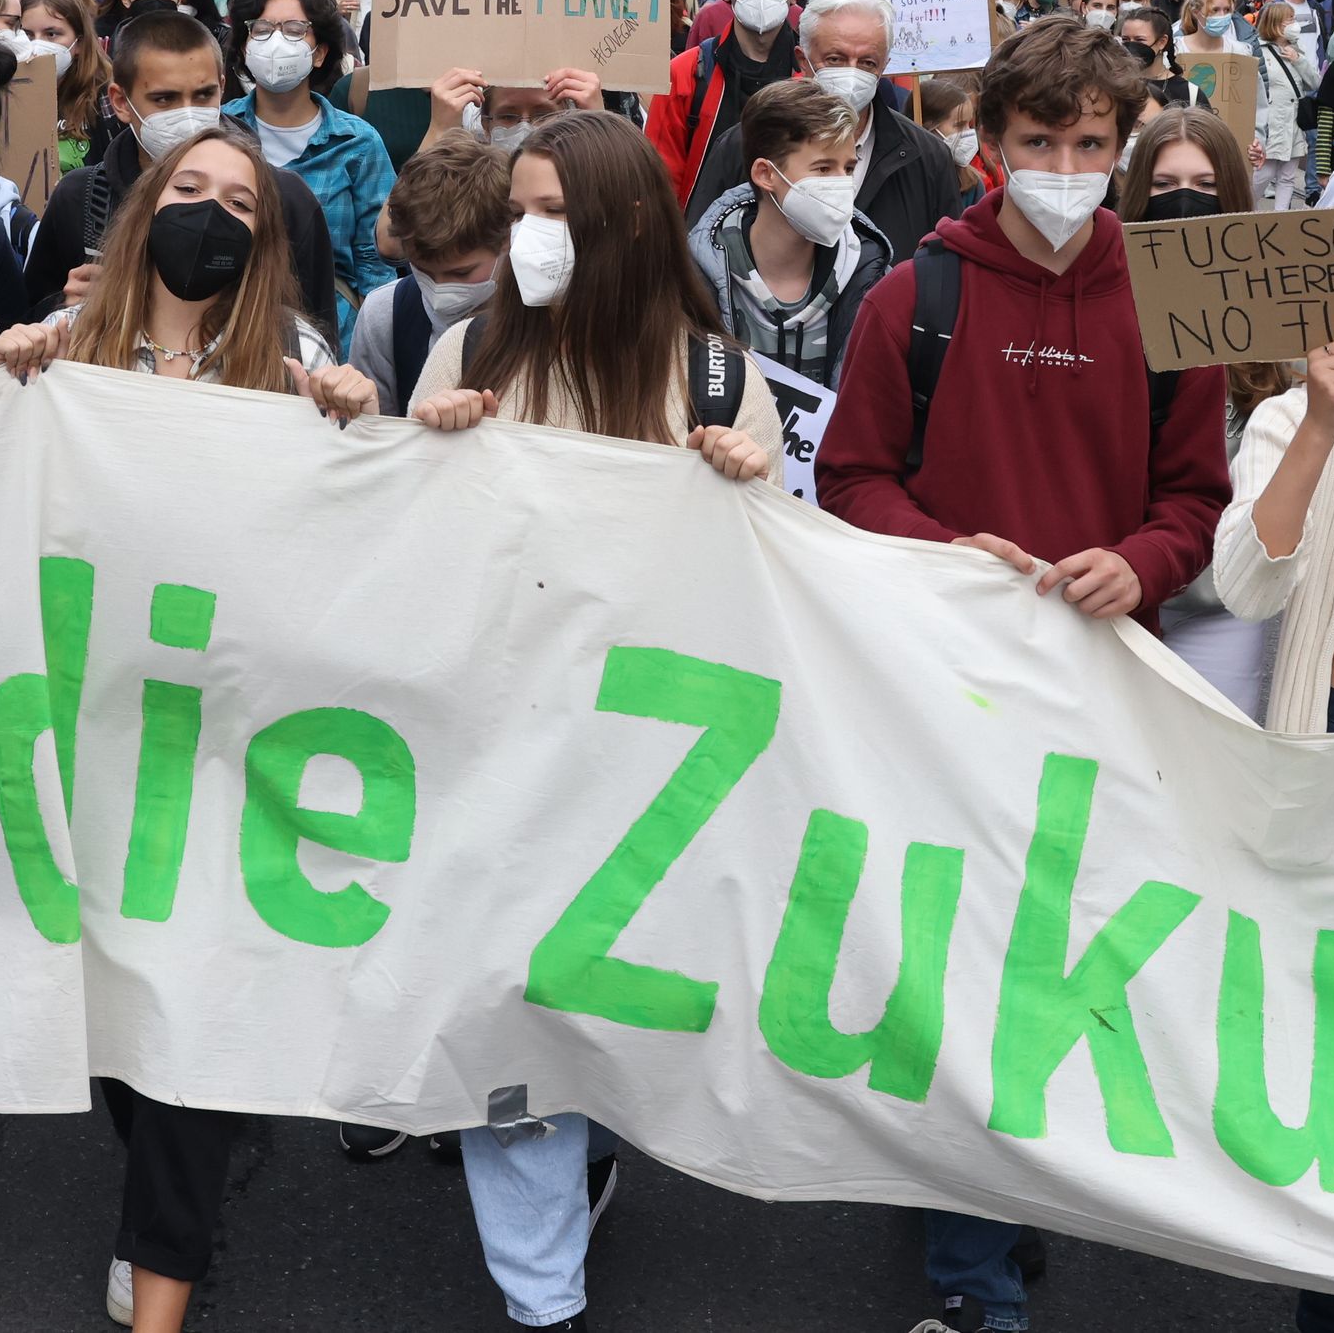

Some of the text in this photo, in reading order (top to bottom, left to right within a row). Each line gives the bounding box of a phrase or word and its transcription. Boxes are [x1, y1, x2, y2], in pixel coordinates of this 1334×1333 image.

[589, 17, 641, 67] #GOVEGAN
[1130, 222, 1286, 269] FUCK
[1168, 306, 1253, 359] NO
